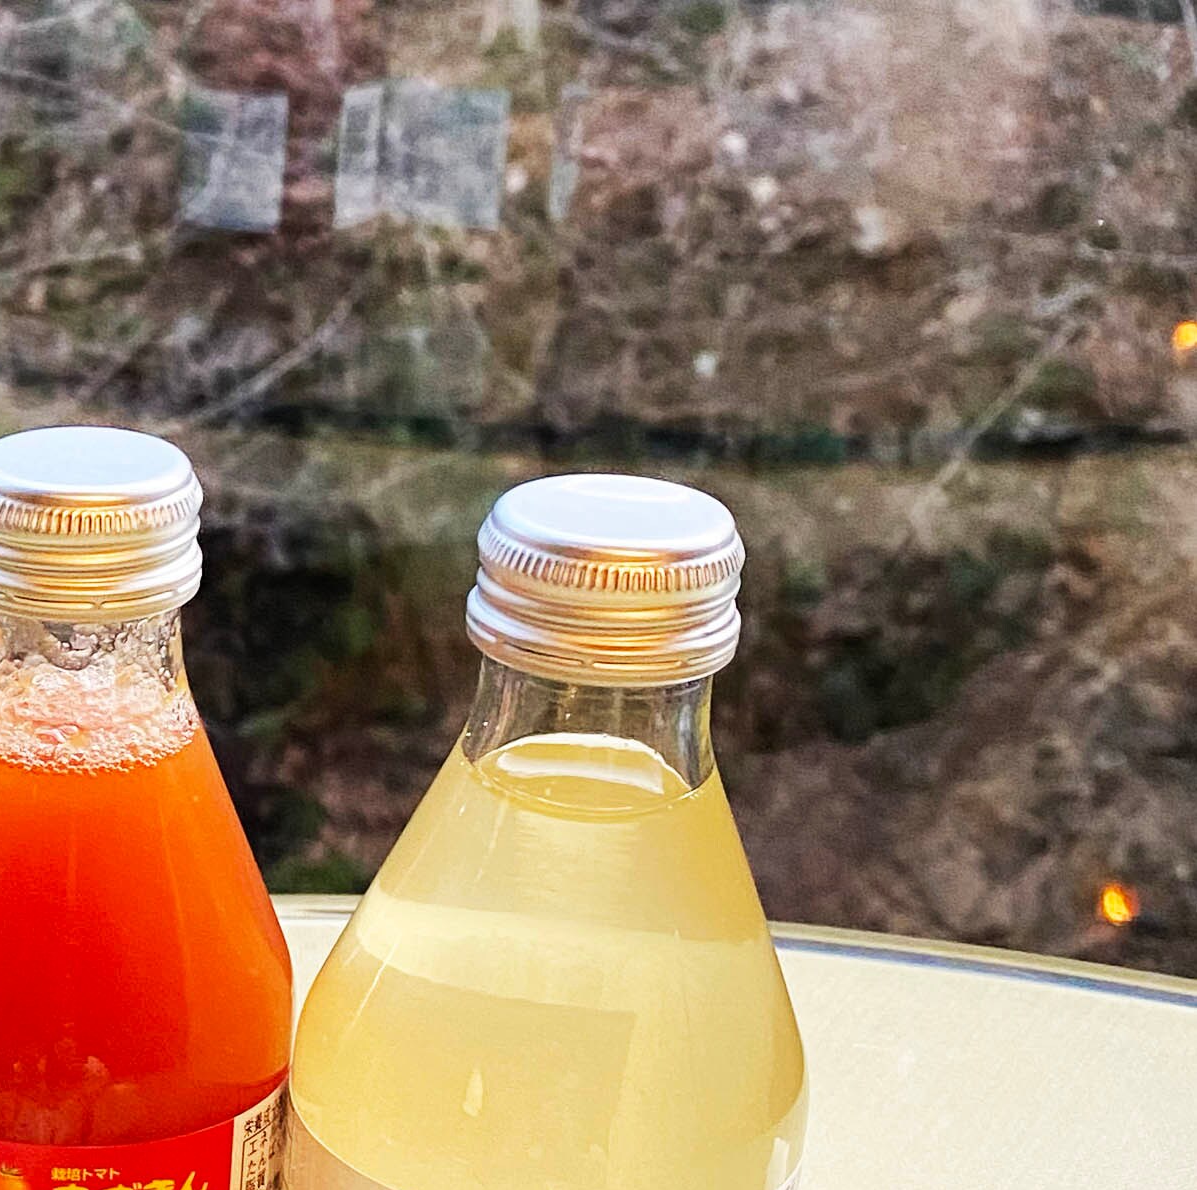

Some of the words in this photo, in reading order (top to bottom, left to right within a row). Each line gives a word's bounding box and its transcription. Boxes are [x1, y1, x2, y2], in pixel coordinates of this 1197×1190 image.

[51, 1167, 121, 1182] 栽培トマト
